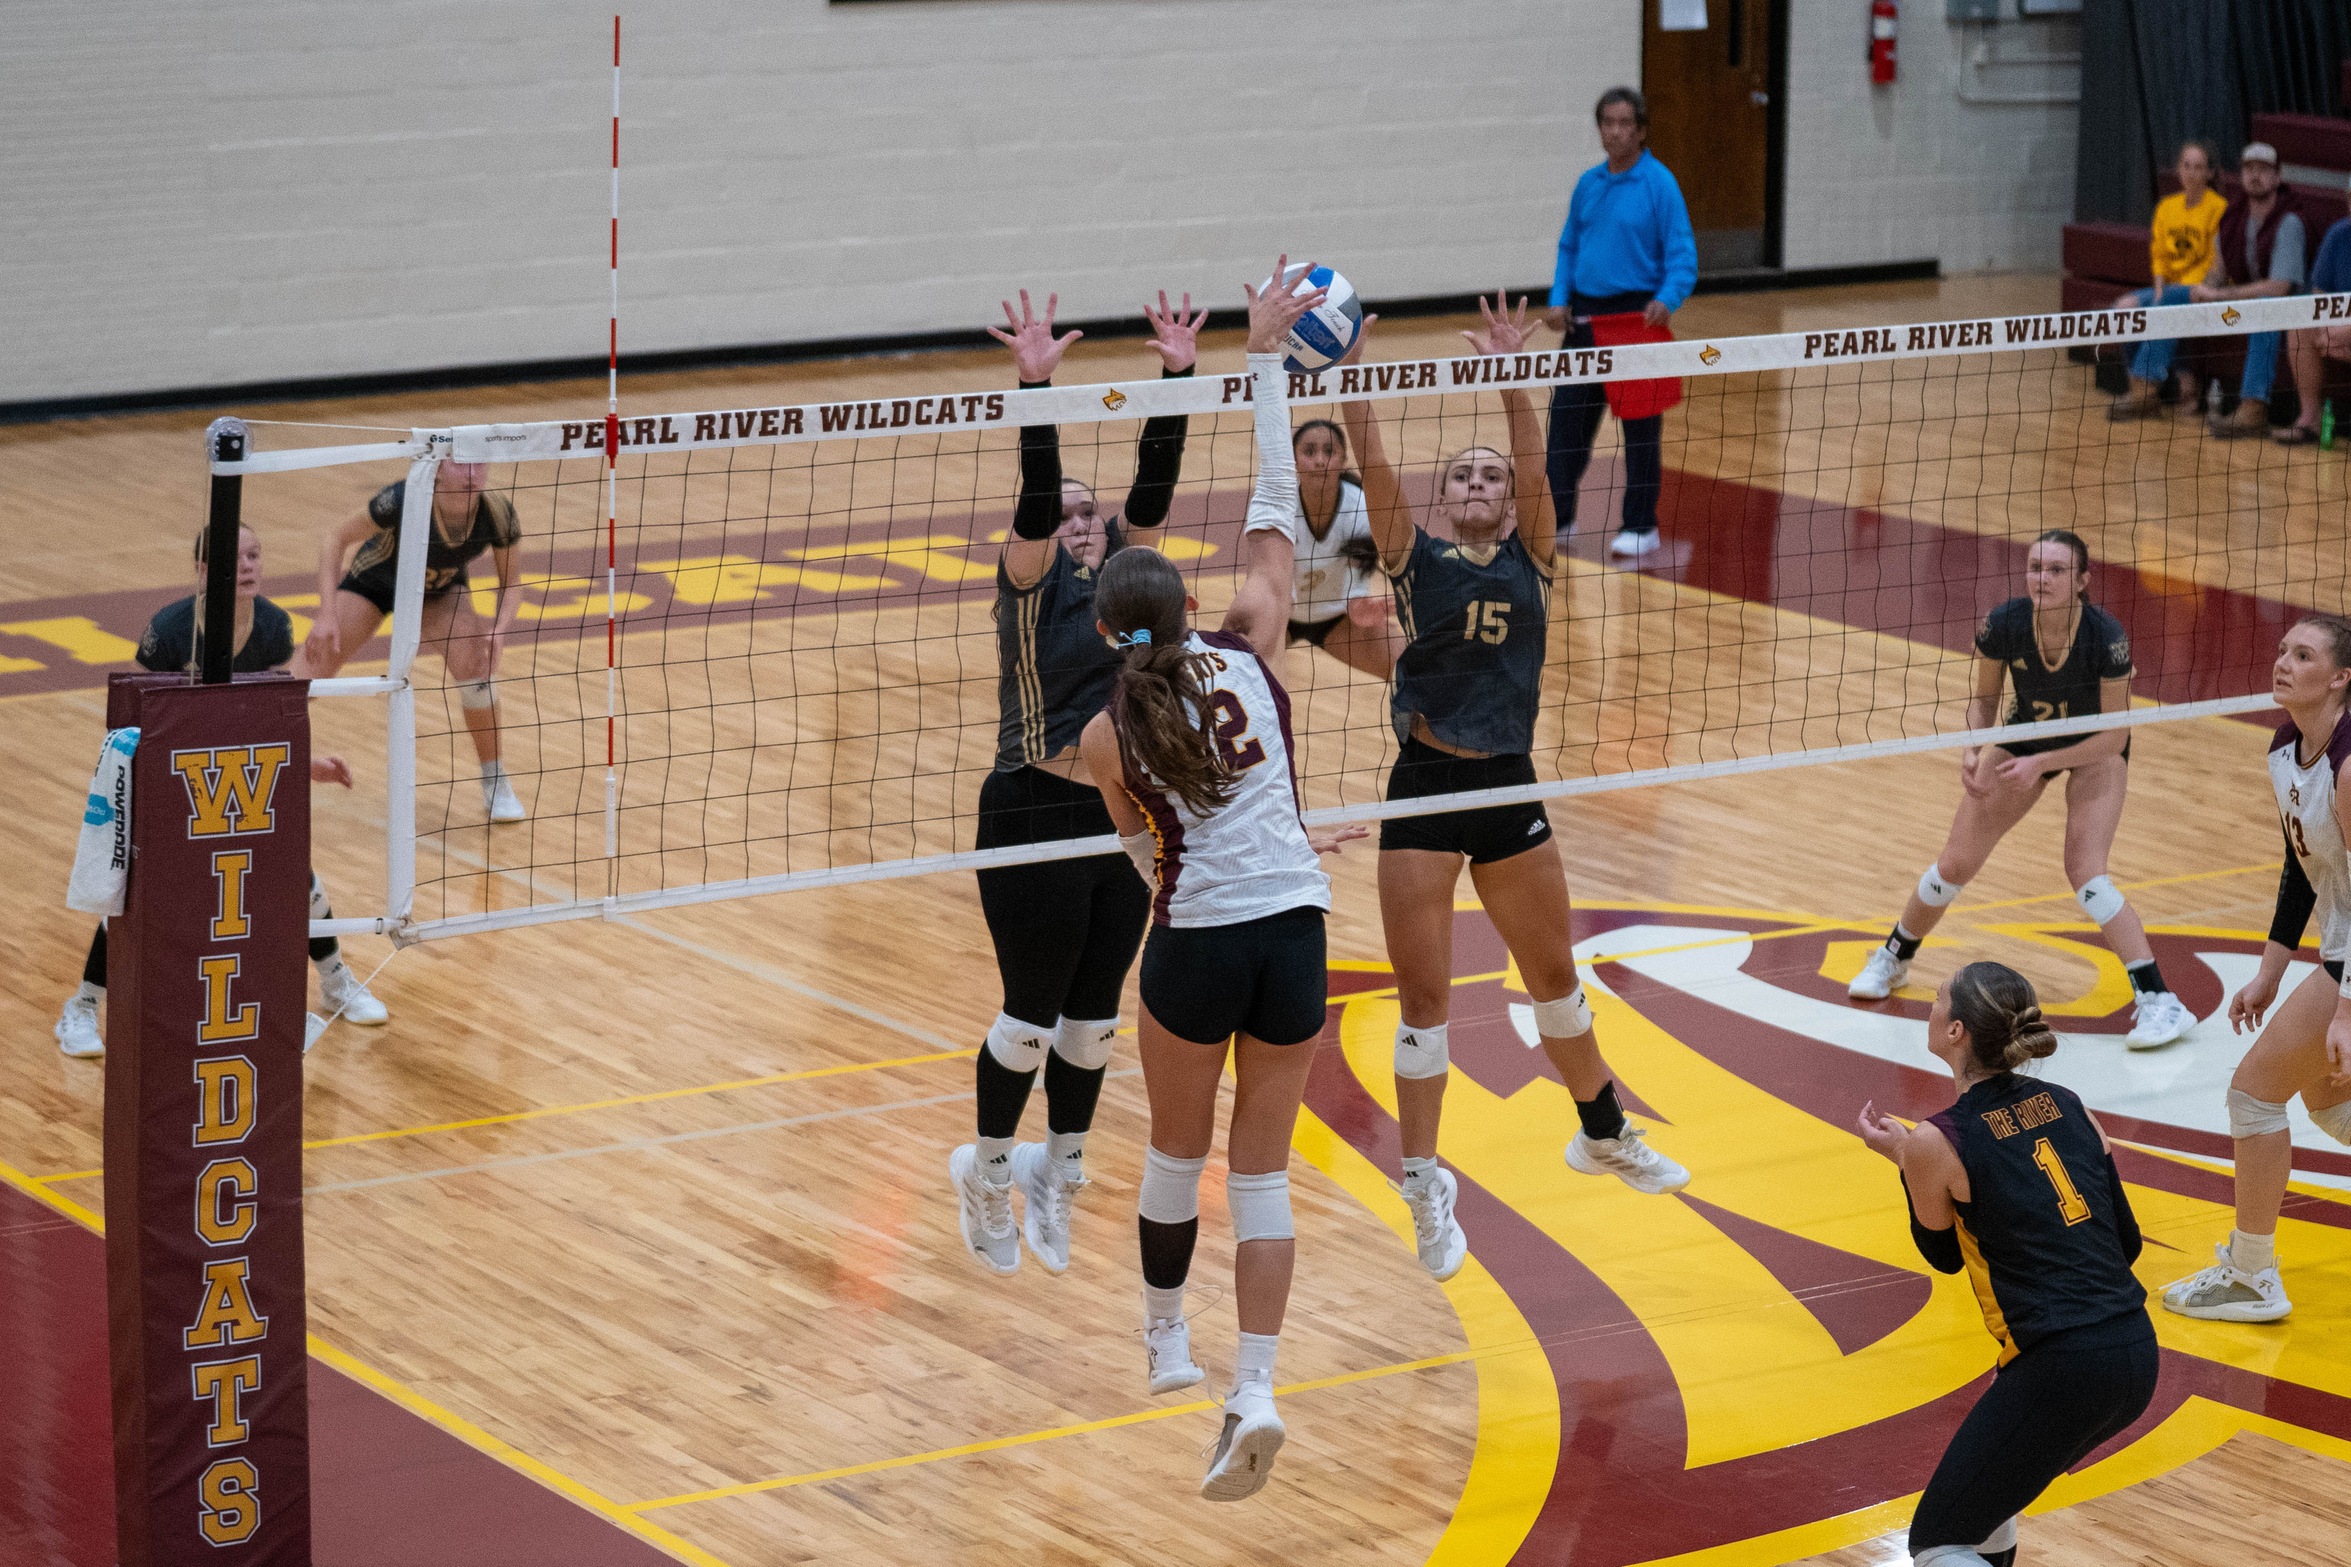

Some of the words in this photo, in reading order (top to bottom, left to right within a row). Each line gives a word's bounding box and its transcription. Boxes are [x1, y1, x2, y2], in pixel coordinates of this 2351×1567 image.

[1283, 335, 1304, 352] JCAA
[1803, 328, 1897, 359] PEARL
[1906, 320, 1994, 351] RIVER
[2005, 309, 2148, 343] WILDCATS
[1221, 372, 1327, 404] PRL
[1339, 361, 1438, 395] RIVER
[1451, 349, 1614, 386] WILDCATS
[484, 434, 502, 444] sports
[503, 434, 527, 443] imports
[693, 407, 804, 442] RIVER
[819, 393, 1005, 433] WILDCATS
[1463, 600, 1512, 645] 15
[110, 765, 126, 870] POWERADE
[2284, 811, 2312, 858] 13
[1980, 1107, 2021, 1140] THE
[2011, 1091, 2063, 1131] RIVER
[170, 740, 292, 1548] WILDCATS
[2032, 1136, 2093, 1227] 1
